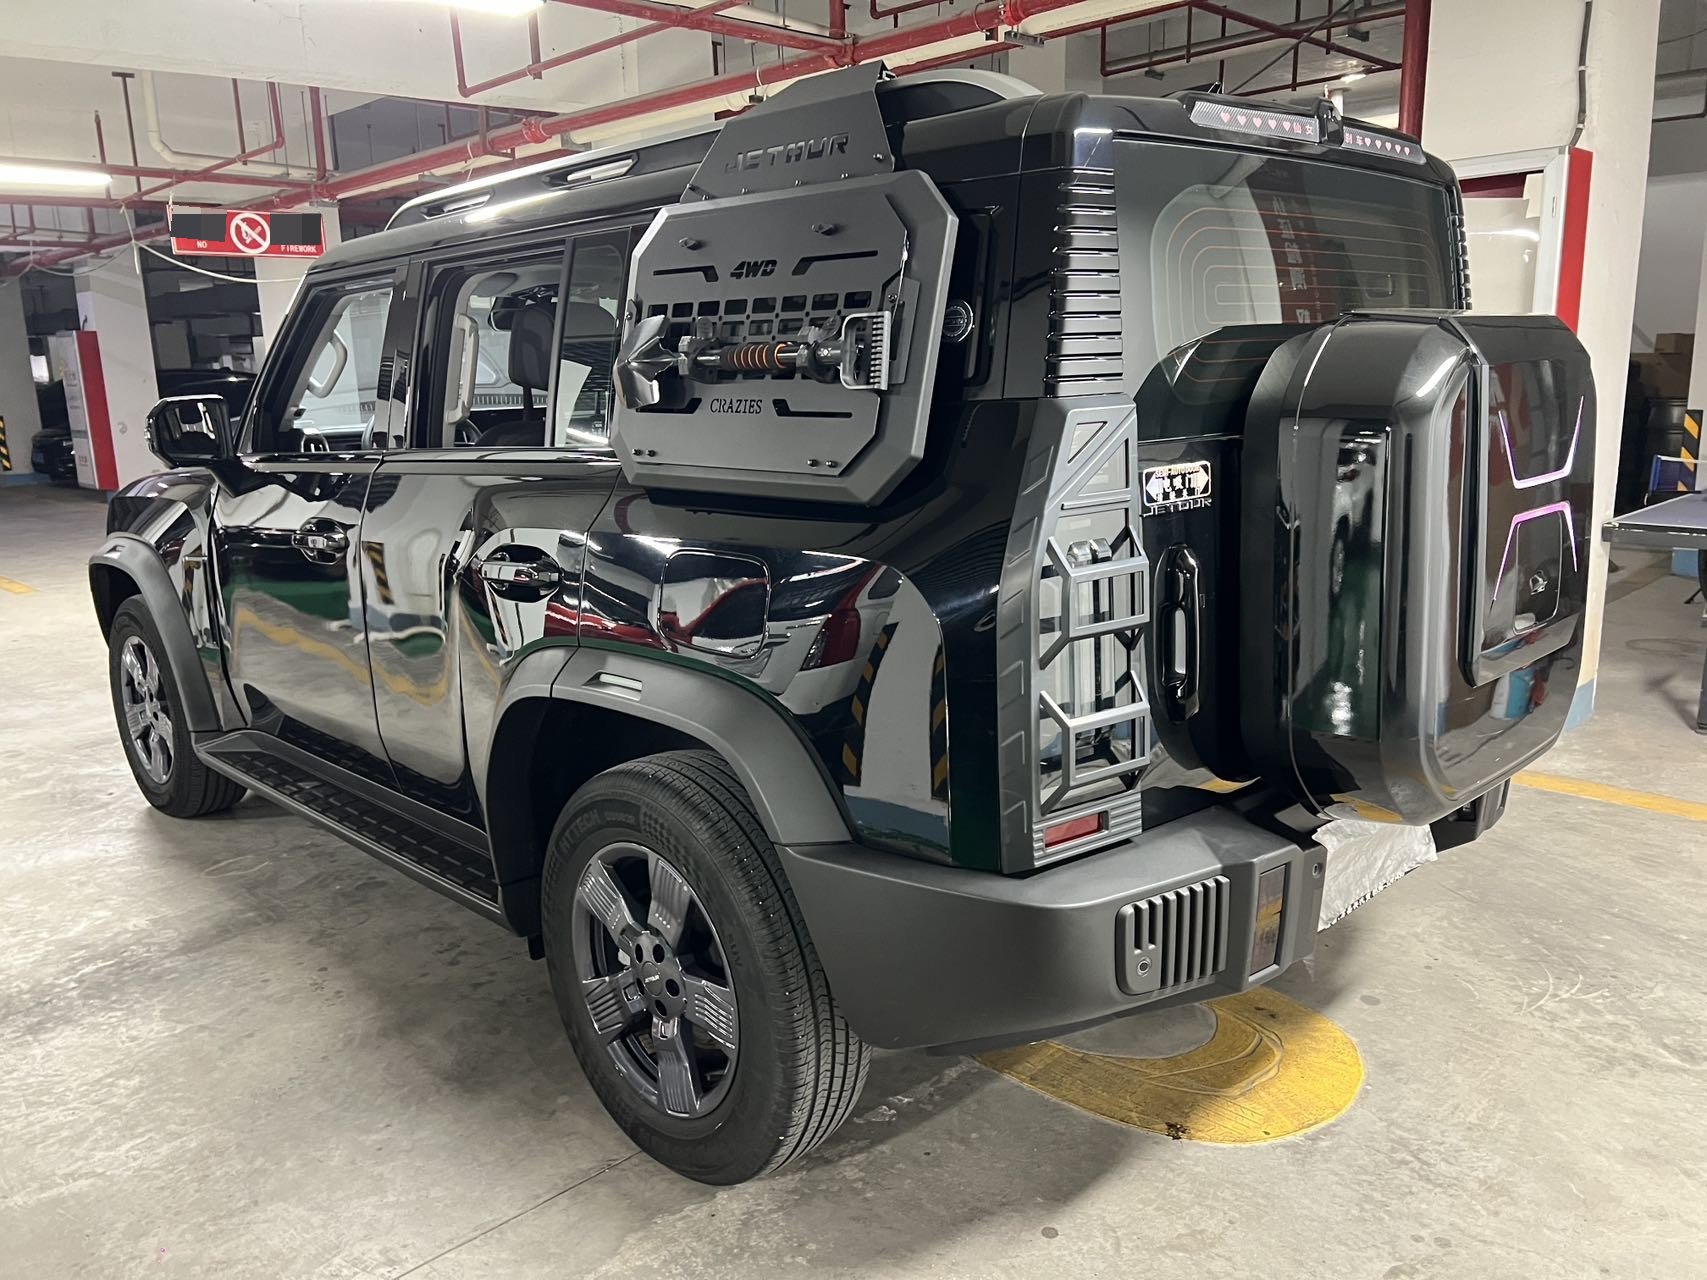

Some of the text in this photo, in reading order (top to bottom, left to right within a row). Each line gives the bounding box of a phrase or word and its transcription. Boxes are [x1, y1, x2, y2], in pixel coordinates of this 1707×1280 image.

[724, 132, 849, 174] JETOUR
[196, 240, 317, 254] NO FIREWORK
[730, 260, 778, 279] 4WD
[710, 397, 762, 414] CRAZIES
[1143, 498, 1212, 517] JETOUR
